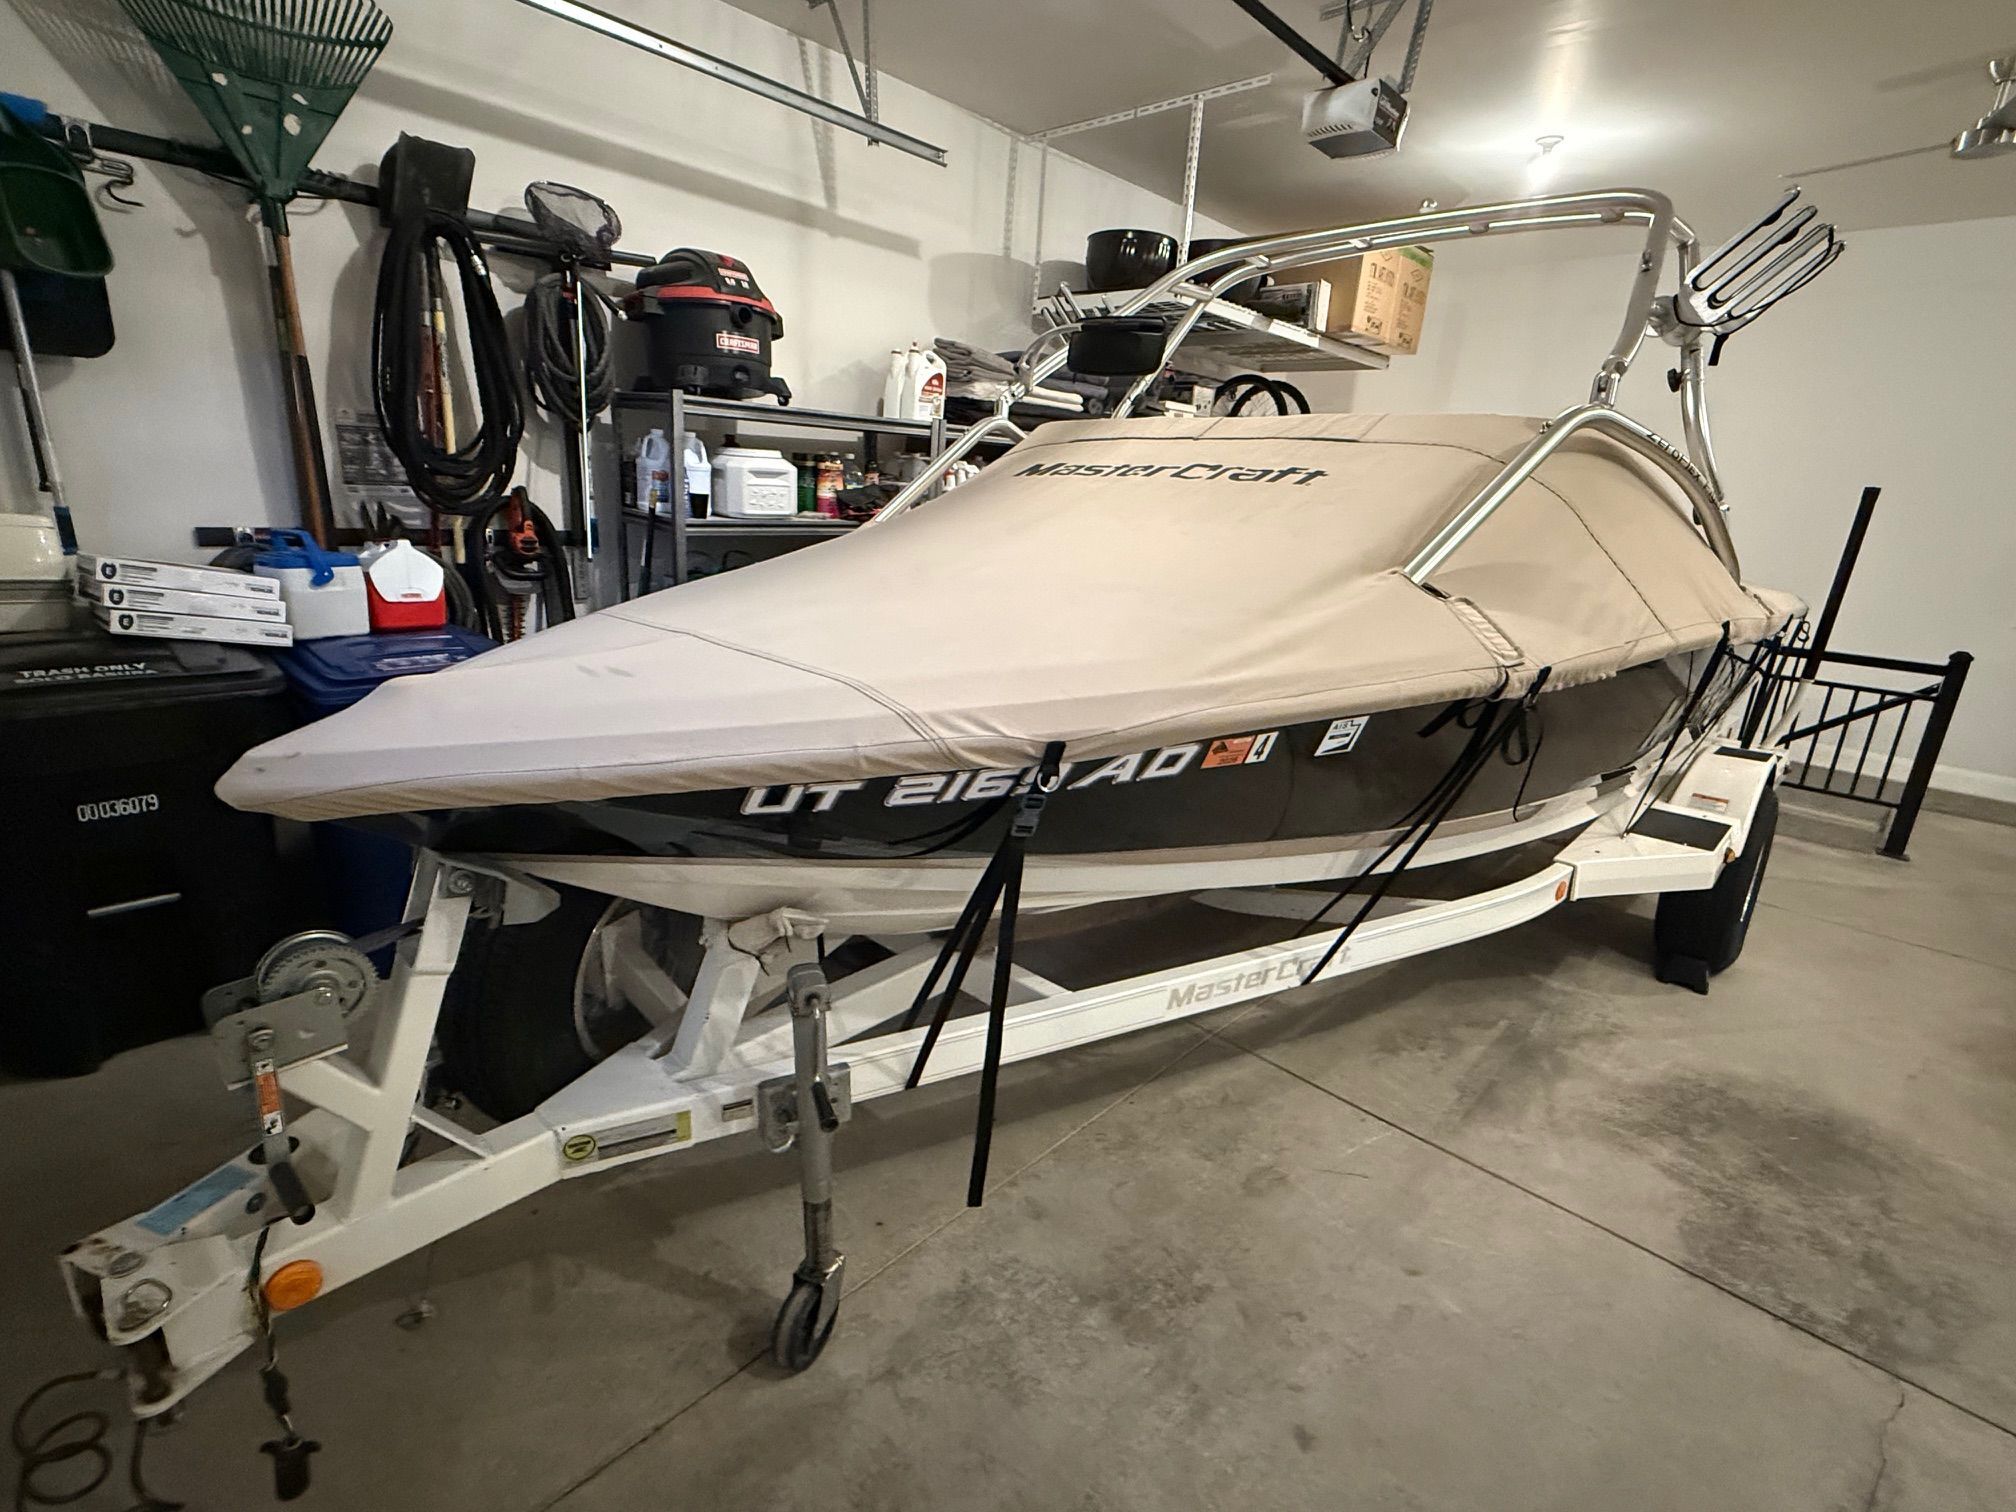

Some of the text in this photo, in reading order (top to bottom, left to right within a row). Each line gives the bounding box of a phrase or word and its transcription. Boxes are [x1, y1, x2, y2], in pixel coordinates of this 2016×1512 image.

[1013, 463, 1329, 485] MasterCraft
[19, 662, 146, 678] TRASH ONLY
[1253, 734, 1271, 760] 4
[740, 782, 865, 815] UT
[1067, 743, 1200, 790] AD
